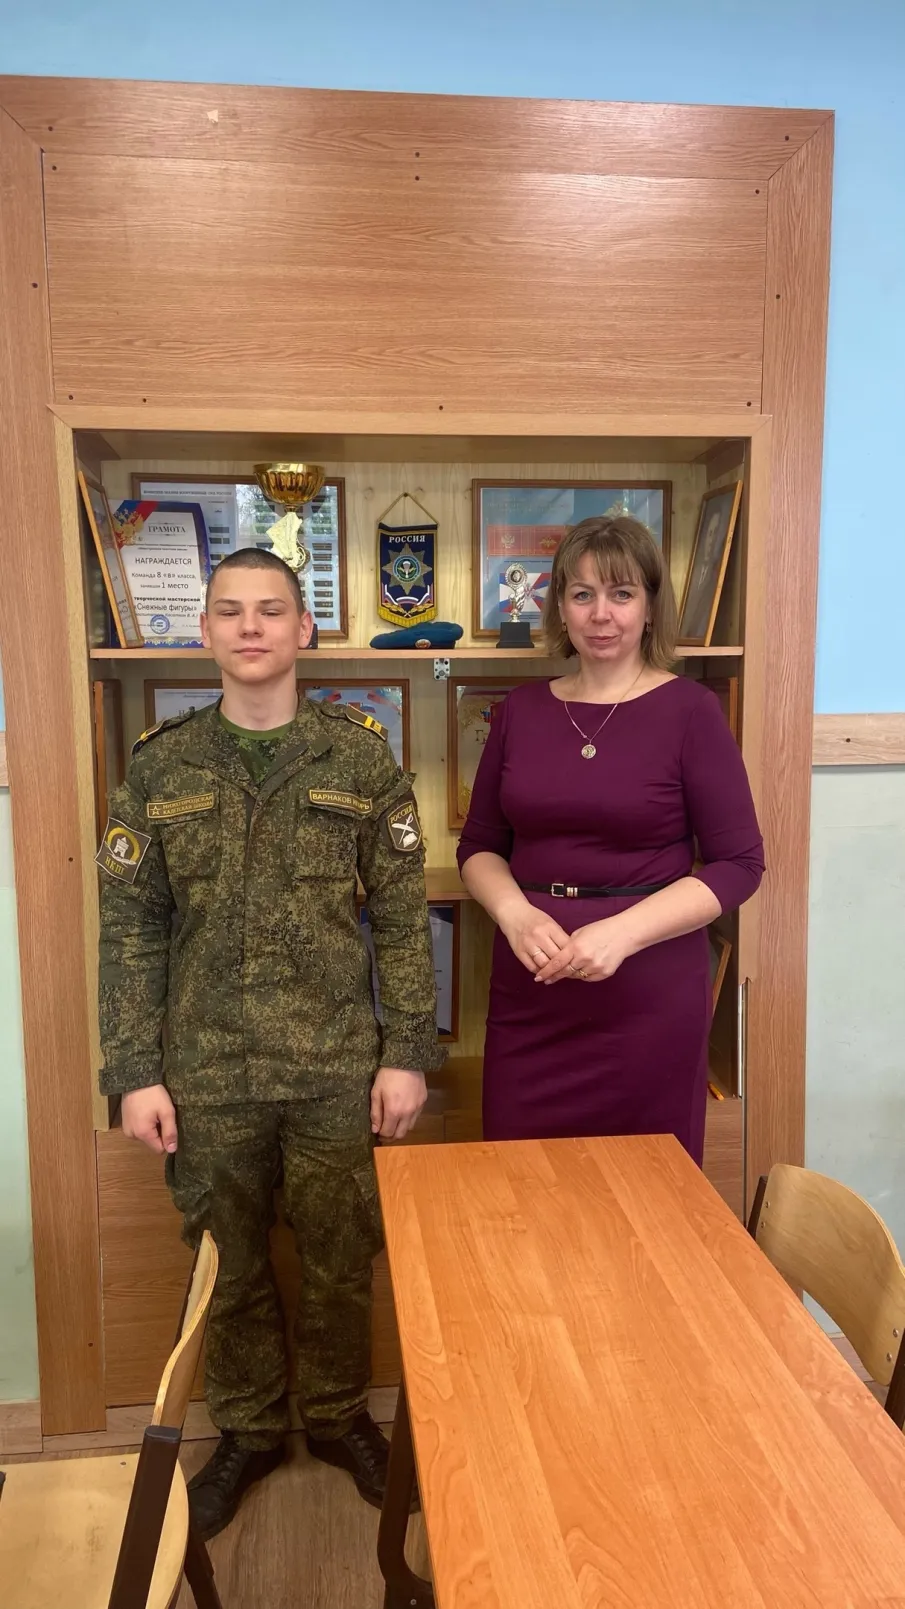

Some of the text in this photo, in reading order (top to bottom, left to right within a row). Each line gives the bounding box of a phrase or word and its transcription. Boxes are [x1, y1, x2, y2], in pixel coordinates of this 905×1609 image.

[148, 525, 186, 533] ГРАМОТА
[388, 535, 426, 543] РОССИЯ
[135, 557, 192, 565] НАГРАЖДАЕТСЯ
[156, 571, 162, 579] 8
[312, 793, 352, 804] ВАРНАКОВ
[163, 804, 193, 815] КАДЕТСКАЯ
[390, 804, 413, 823] РОССИЯ
